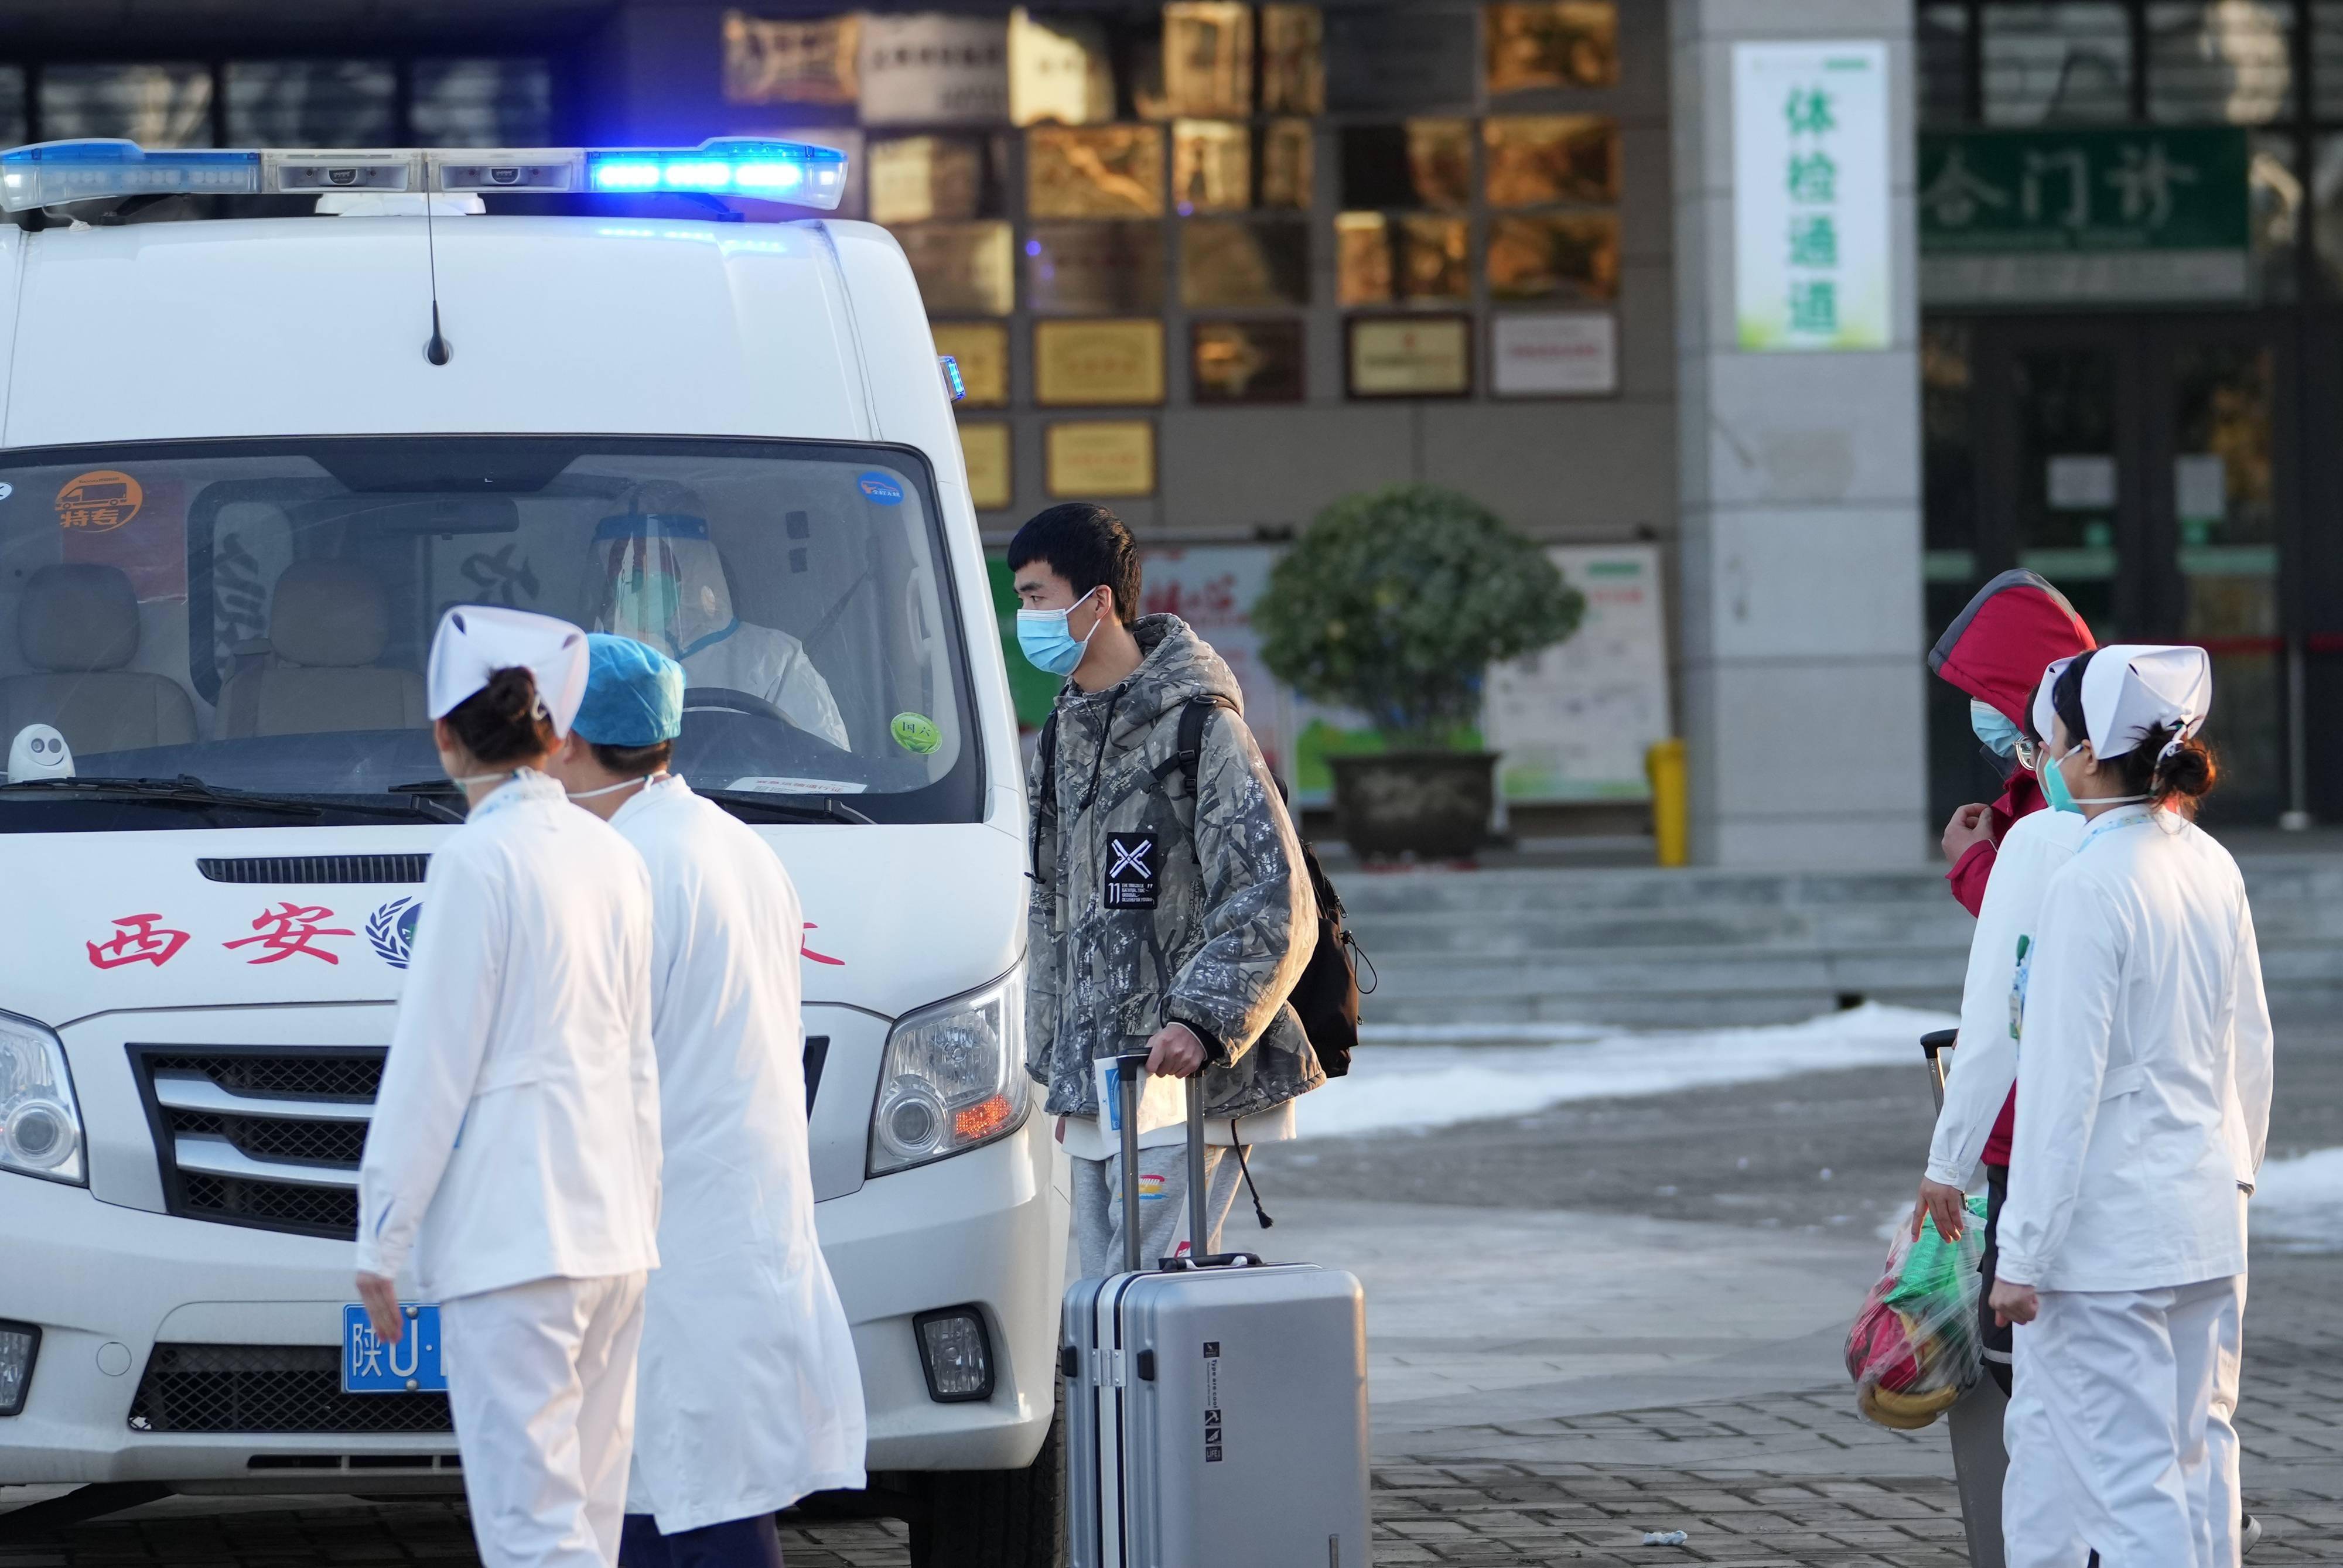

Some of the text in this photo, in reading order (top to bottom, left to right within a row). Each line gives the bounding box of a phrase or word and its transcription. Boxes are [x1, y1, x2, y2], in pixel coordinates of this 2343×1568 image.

[1785, 81, 1838, 333] 体检通道
[60, 508, 119, 528] 特专
[903, 721, 931, 737] 国六
[87, 902, 356, 969] 西安
